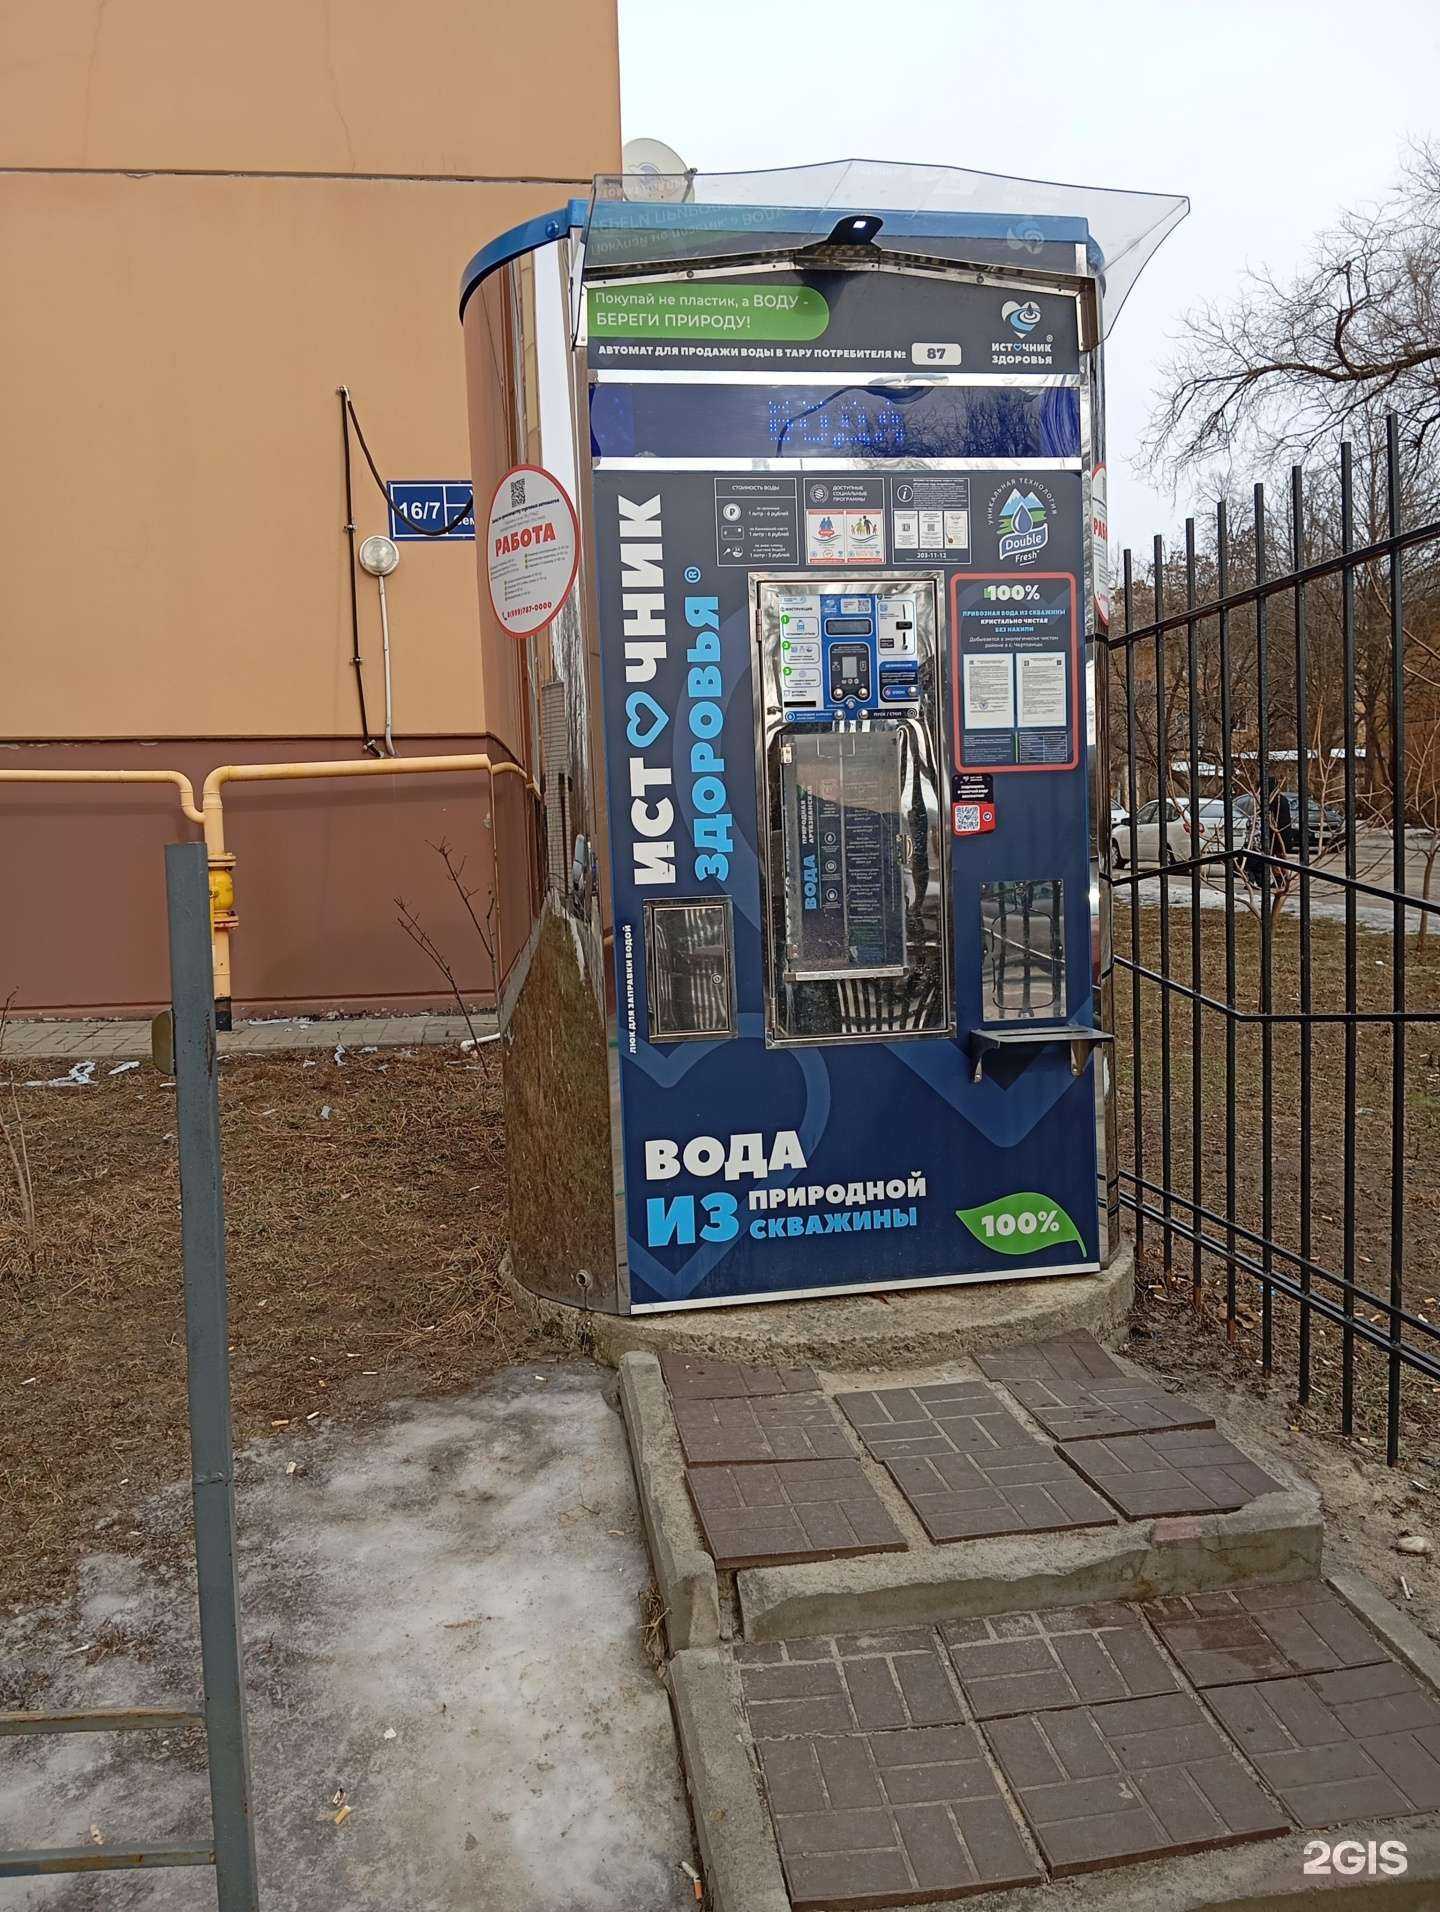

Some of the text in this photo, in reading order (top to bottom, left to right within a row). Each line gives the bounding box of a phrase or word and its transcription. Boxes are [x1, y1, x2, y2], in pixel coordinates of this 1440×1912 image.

[595, 292, 655, 309] Покупай
[658, 295, 676, 305] не
[679, 296, 739, 308] пластик,
[742, 297, 749, 306] а
[753, 294, 798, 310] ВОДУ
[596, 312, 751, 330] БЕРЕГИ ПРИРОДУ!
[598, 345, 653, 356] АВТОМАТ
[655, 346, 679, 357] ДЛЯ
[681, 347, 739, 357] ПРОДАЖИ
[740, 348, 774, 358] ВОДЫ
[775, 349, 783, 357] В
[785, 349, 812, 358] ТАРУ
[814, 349, 892, 359] ПОТРЕБИТЕЛЯ
[926, 348, 946, 360] 87
[991, 355, 1053, 365] ЗДОРОВЬЯ
[399, 501, 441, 520] 16/7
[495, 522, 556, 557] РАБОТА
[1005, 534, 1042, 551] Double
[988, 584, 1041, 601] 100%
[684, 596, 734, 882] ЗДОРОВЬЯ
[803, 854, 818, 911] ВОДА
[622, 925, 637, 1054] ЛЮК ДЛЯ ЗАПРАВКИ ВОДОЙ
[644, 1130, 807, 1181] ВОДА
[748, 1171, 927, 1211] ПРИРОДНОЙ
[646, 1191, 739, 1247] ИЗ
[749, 1207, 918, 1240] СКВАЖИНЫ
[980, 1209, 1061, 1238] 100%
